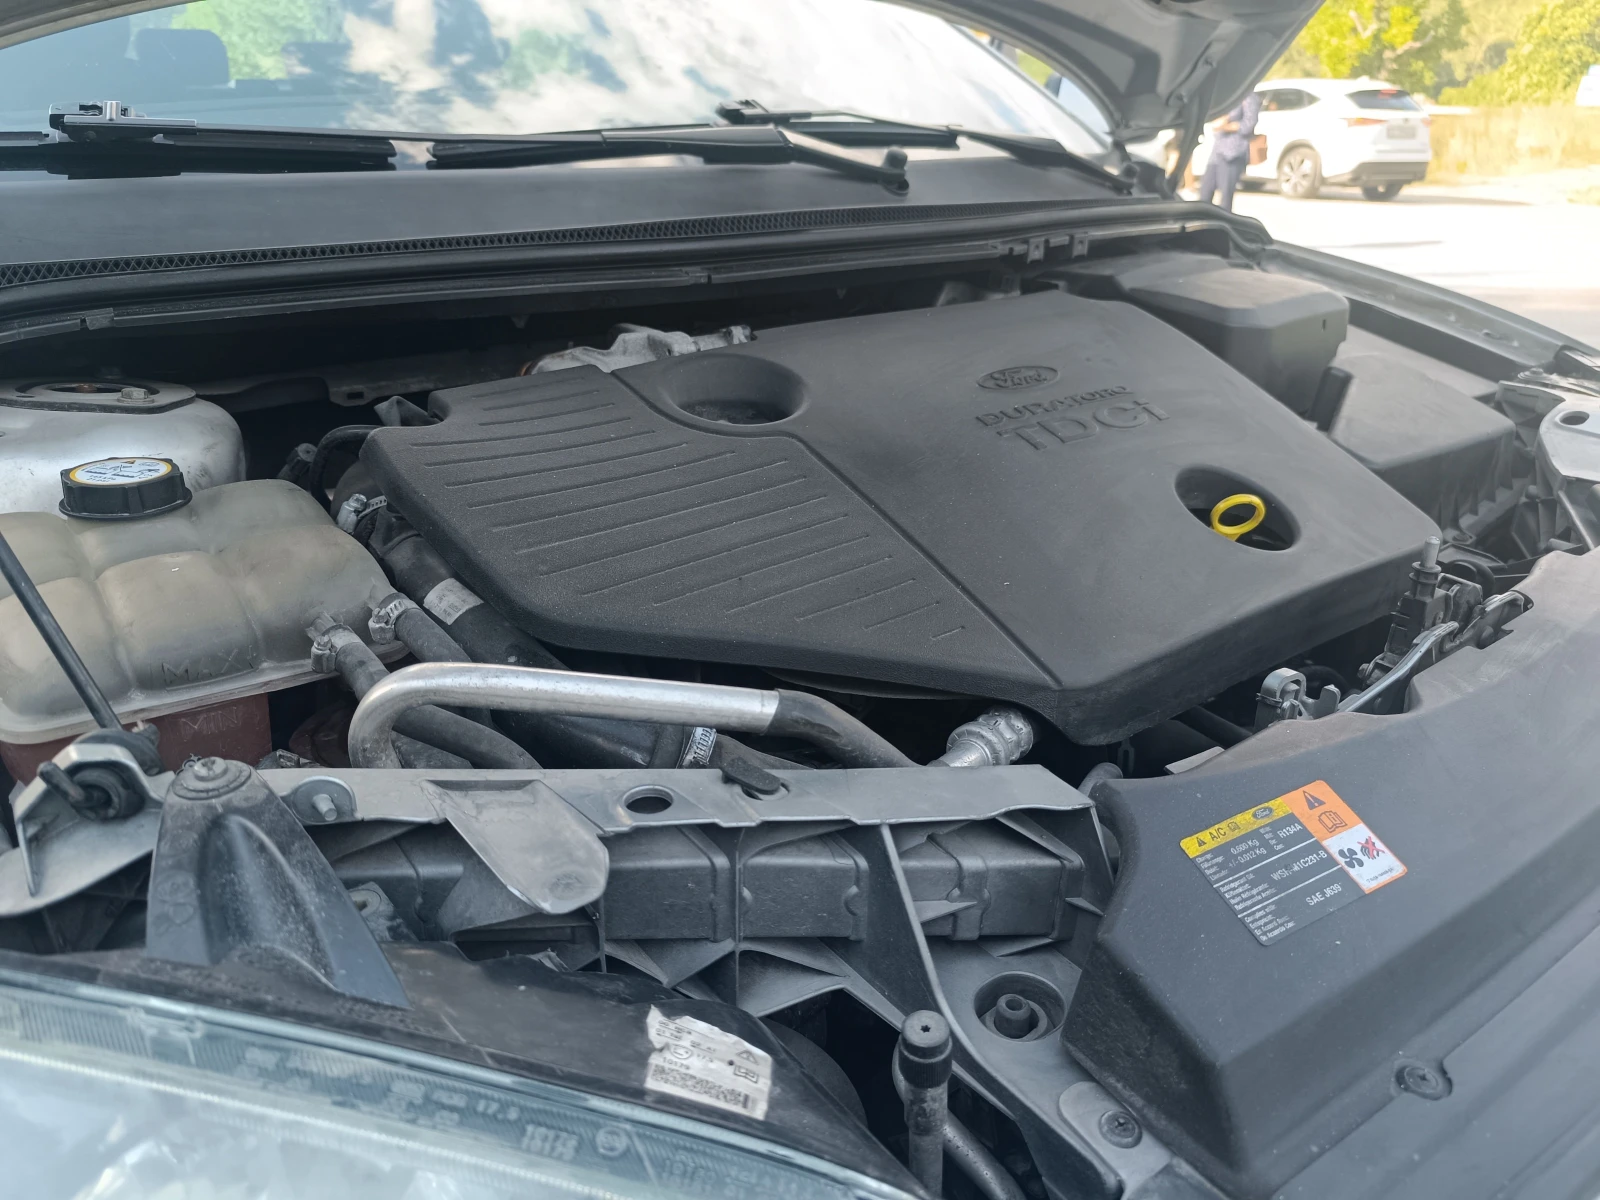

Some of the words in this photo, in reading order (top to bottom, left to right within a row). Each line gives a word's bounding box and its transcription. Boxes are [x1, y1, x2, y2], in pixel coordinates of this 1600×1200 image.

[990, 368, 1048, 388] Ford
[1207, 827, 1227, 841] A/C
[1277, 823, 1303, 838] R134A
[1247, 838, 1260, 848] Kg
[1254, 846, 1267, 856] Kg
[1305, 892, 1325, 906] SAE
[1322, 884, 1343, 898] J639
